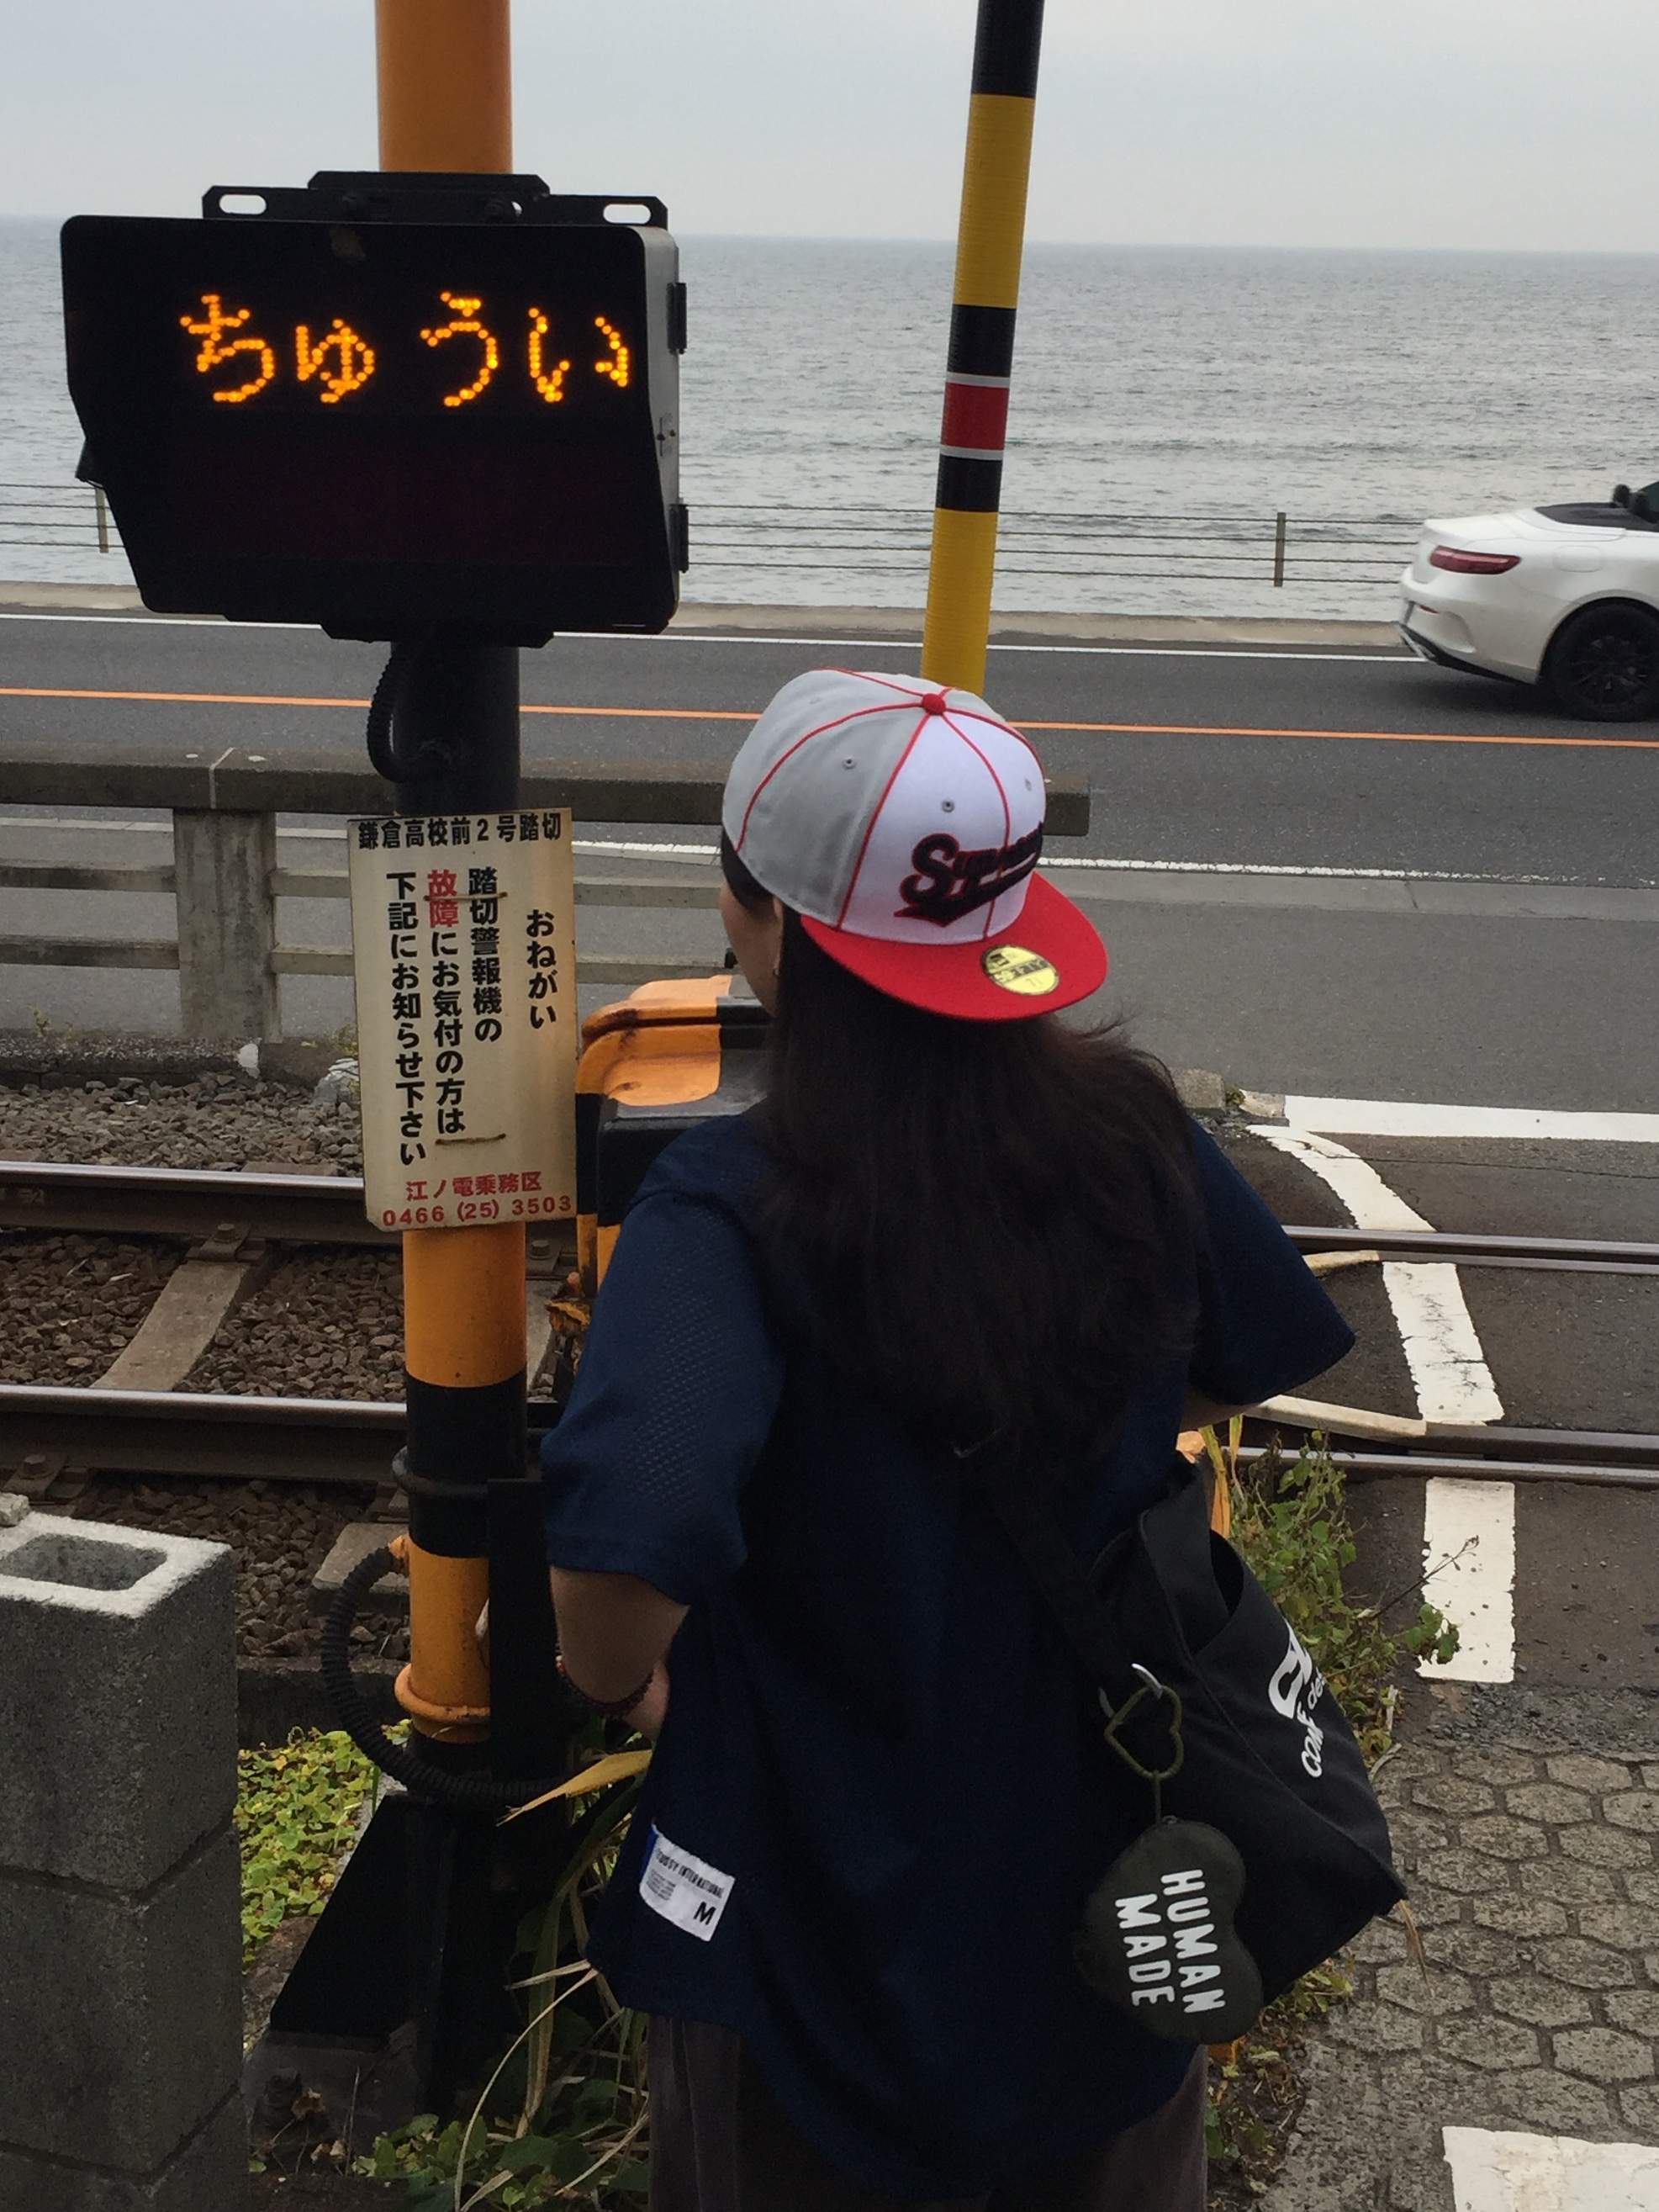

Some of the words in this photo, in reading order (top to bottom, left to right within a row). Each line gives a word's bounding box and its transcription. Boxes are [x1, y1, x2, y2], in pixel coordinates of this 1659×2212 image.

[180, 291, 629, 408] ちゅうい
[358, 812, 562, 849] 鎌倉高校前2号踏切
[427, 869, 466, 1135] 故障にお気付の方は
[468, 866, 502, 1042] 踏切警報機の
[526, 909, 558, 1029] おねがい
[386, 871, 426, 1166] 下記にお知らせ下さい
[383, 1205, 445, 1226] 0466
[457, 1199, 499, 1222] (25)
[511, 1195, 572, 1215] 3503
[406, 1171, 542, 1201] 江ノ電乗務区
[693, 1901, 717, 1925] M
[1114, 1893, 1175, 2007] MADE
[1160, 1869, 1225, 2014] HUMAN
